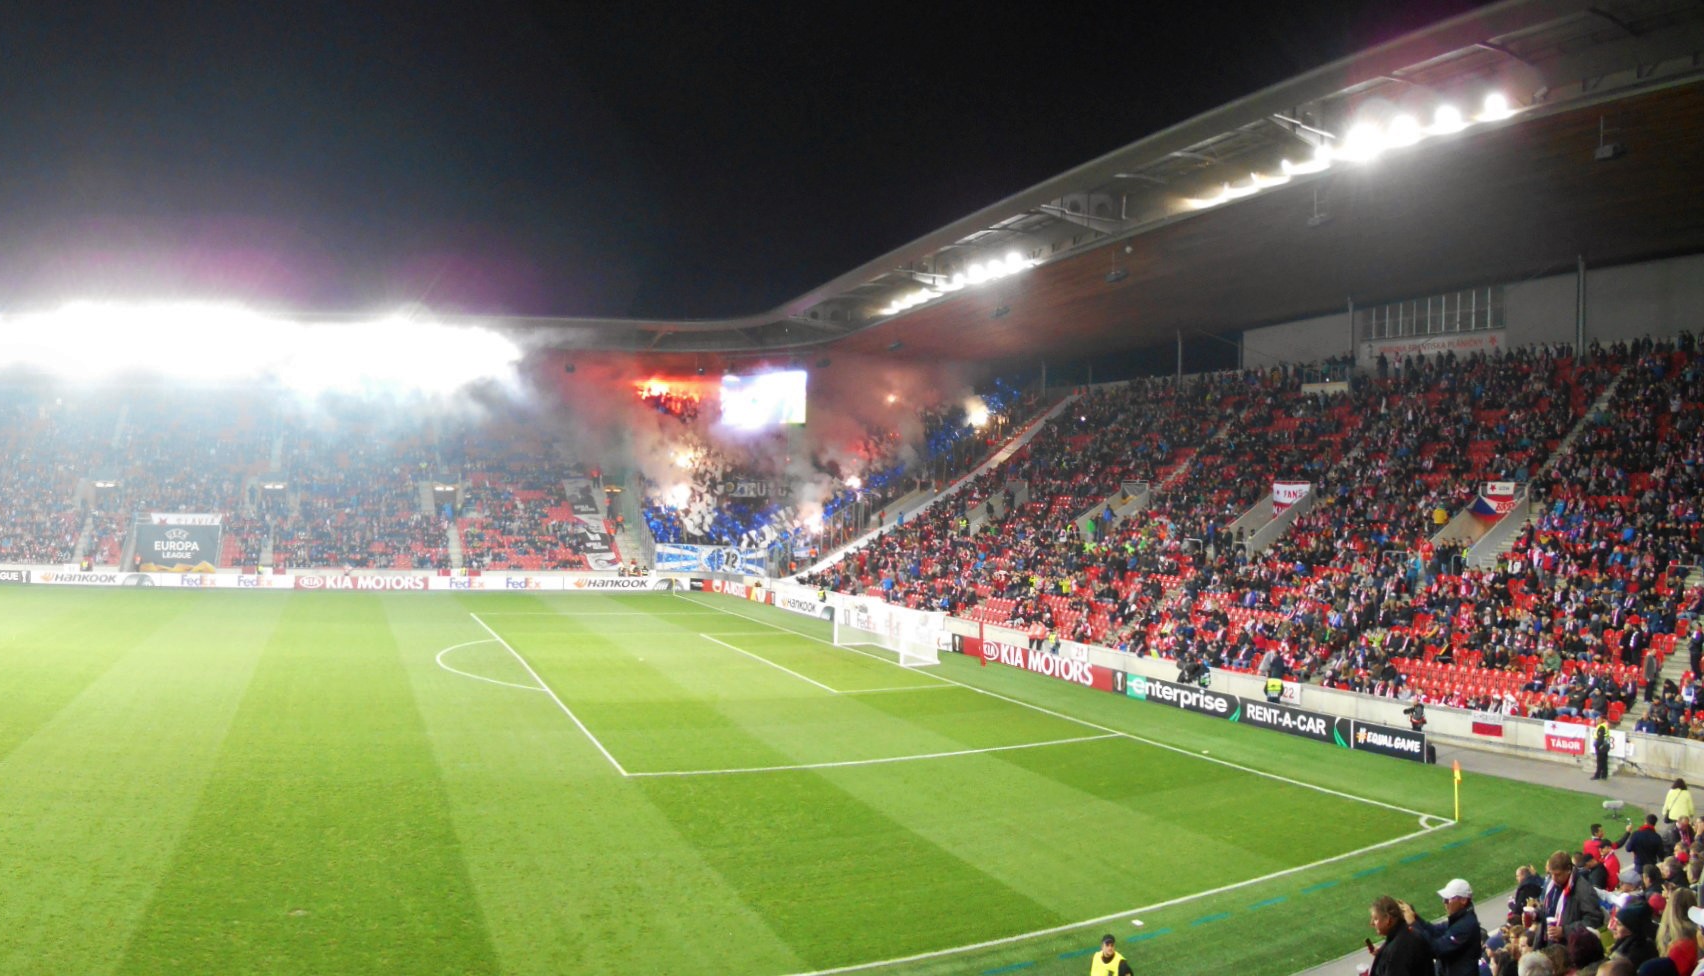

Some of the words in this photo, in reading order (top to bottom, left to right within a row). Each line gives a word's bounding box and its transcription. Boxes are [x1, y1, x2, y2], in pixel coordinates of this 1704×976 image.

[154, 541, 199, 551] EUROPA
[180, 575, 216, 586] FedEx
[238, 576, 272, 587] FedEx
[326, 576, 353, 589] KIA
[357, 576, 424, 589] MOTORS
[450, 577, 485, 588] FedEx
[506, 578, 541, 589] FedEx
[1000, 644, 1024, 668] KIA
[1028, 649, 1094, 686] MOTORS
[1127, 677, 1228, 713] enterprise
[1246, 703, 1327, 736] RENT-A-CAR
